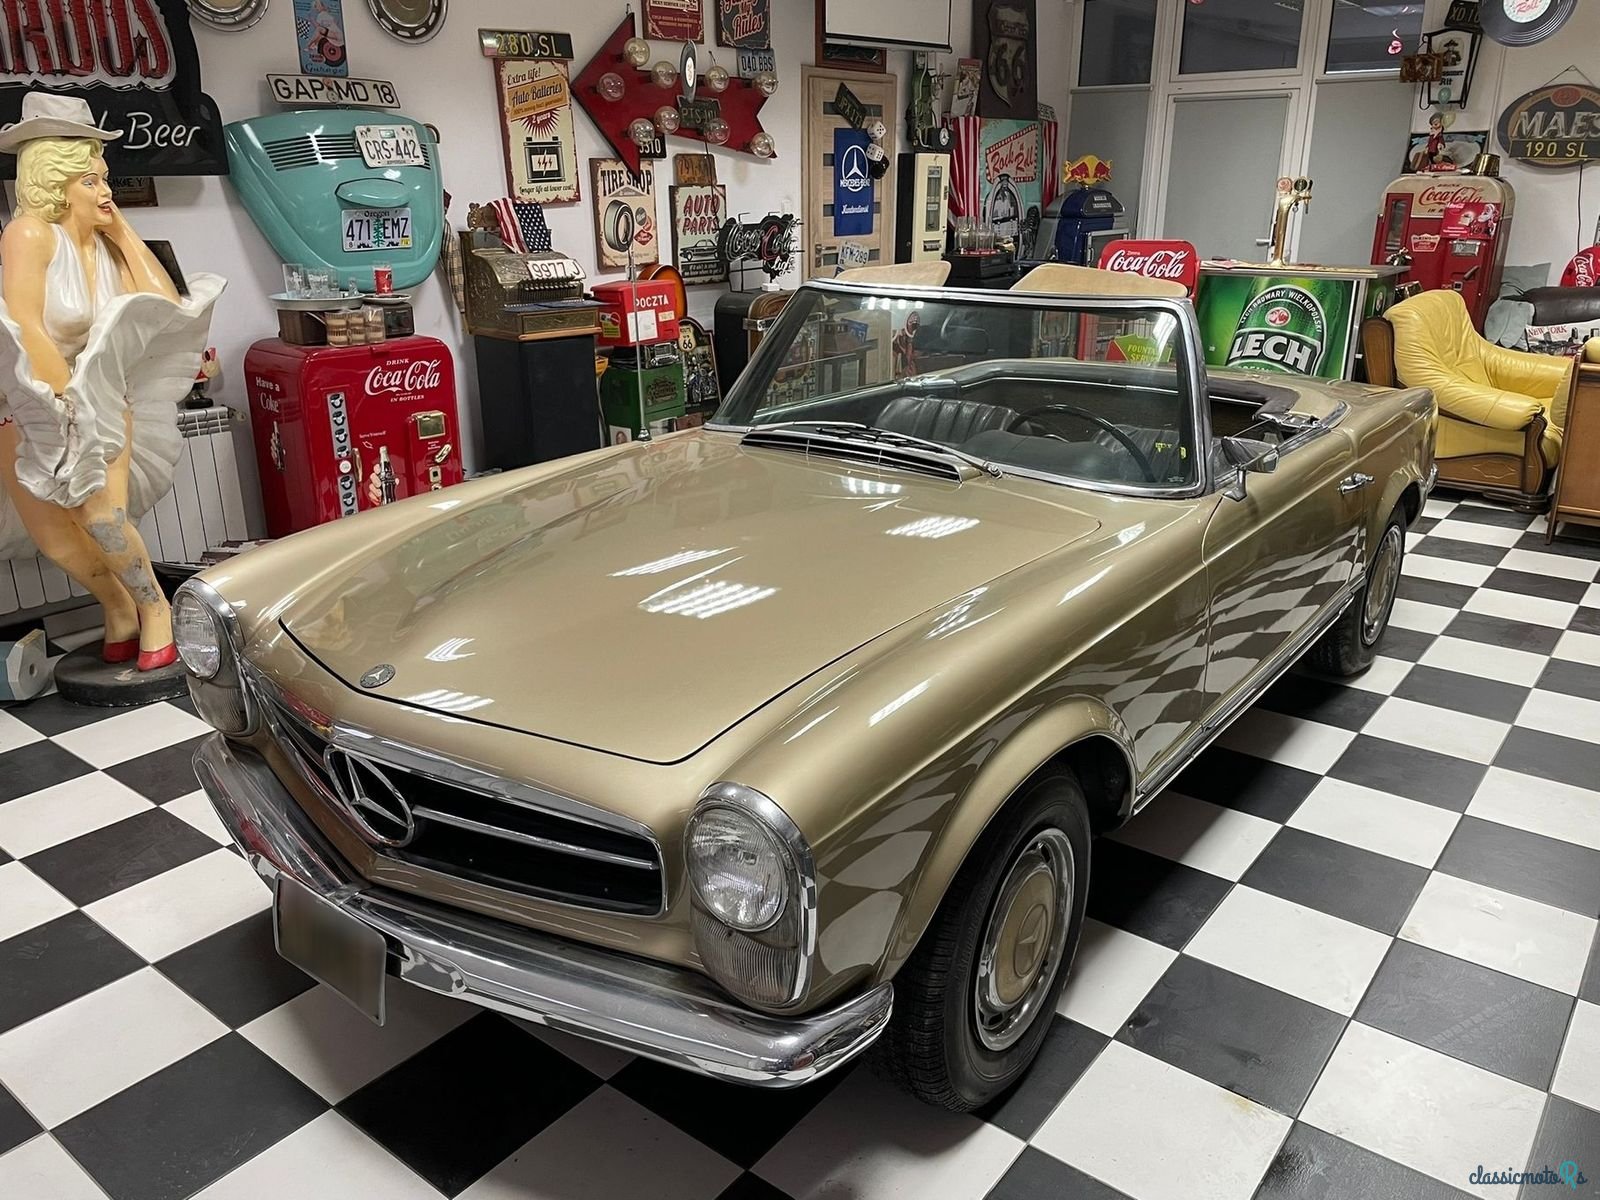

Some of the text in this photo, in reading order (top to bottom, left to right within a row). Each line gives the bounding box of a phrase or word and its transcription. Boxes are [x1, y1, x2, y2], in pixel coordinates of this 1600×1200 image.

[733, 13, 764, 39] Rules
[496, 33, 562, 57] 280 SL
[507, 66, 542, 85] Extra life!
[273, 78, 395, 104] GAP MD 18
[511, 81, 563, 108] Auto Batteries
[536, 112, 551, 124] years
[123, 111, 201, 150] Beer
[1525, 141, 1589, 157] 190 SL
[519, 185, 535, 195] Longer
[535, 184, 543, 194] life
[549, 184, 562, 192] lower
[600, 169, 624, 196] TIRE
[683, 194, 720, 217] AUTO
[1419, 186, 1483, 206] Coca-Cola
[364, 210, 390, 219] Oregon
[346, 217, 409, 241] 471 EMZ
[682, 216, 720, 236] PARTS
[531, 261, 566, 278] 9977
[1106, 249, 1190, 278] Coca-Cola
[1287, 290, 1323, 333] WIELKOPOLSKI
[1528, 324, 1568, 338] NEW ORK
[682, 340, 693, 350] 66
[1229, 333, 1312, 373] LECH
[386, 358, 410, 366] DRINK
[255, 376, 280, 392] Have a
[364, 359, 442, 396] Coca-Cola
[260, 391, 280, 413] Coke
